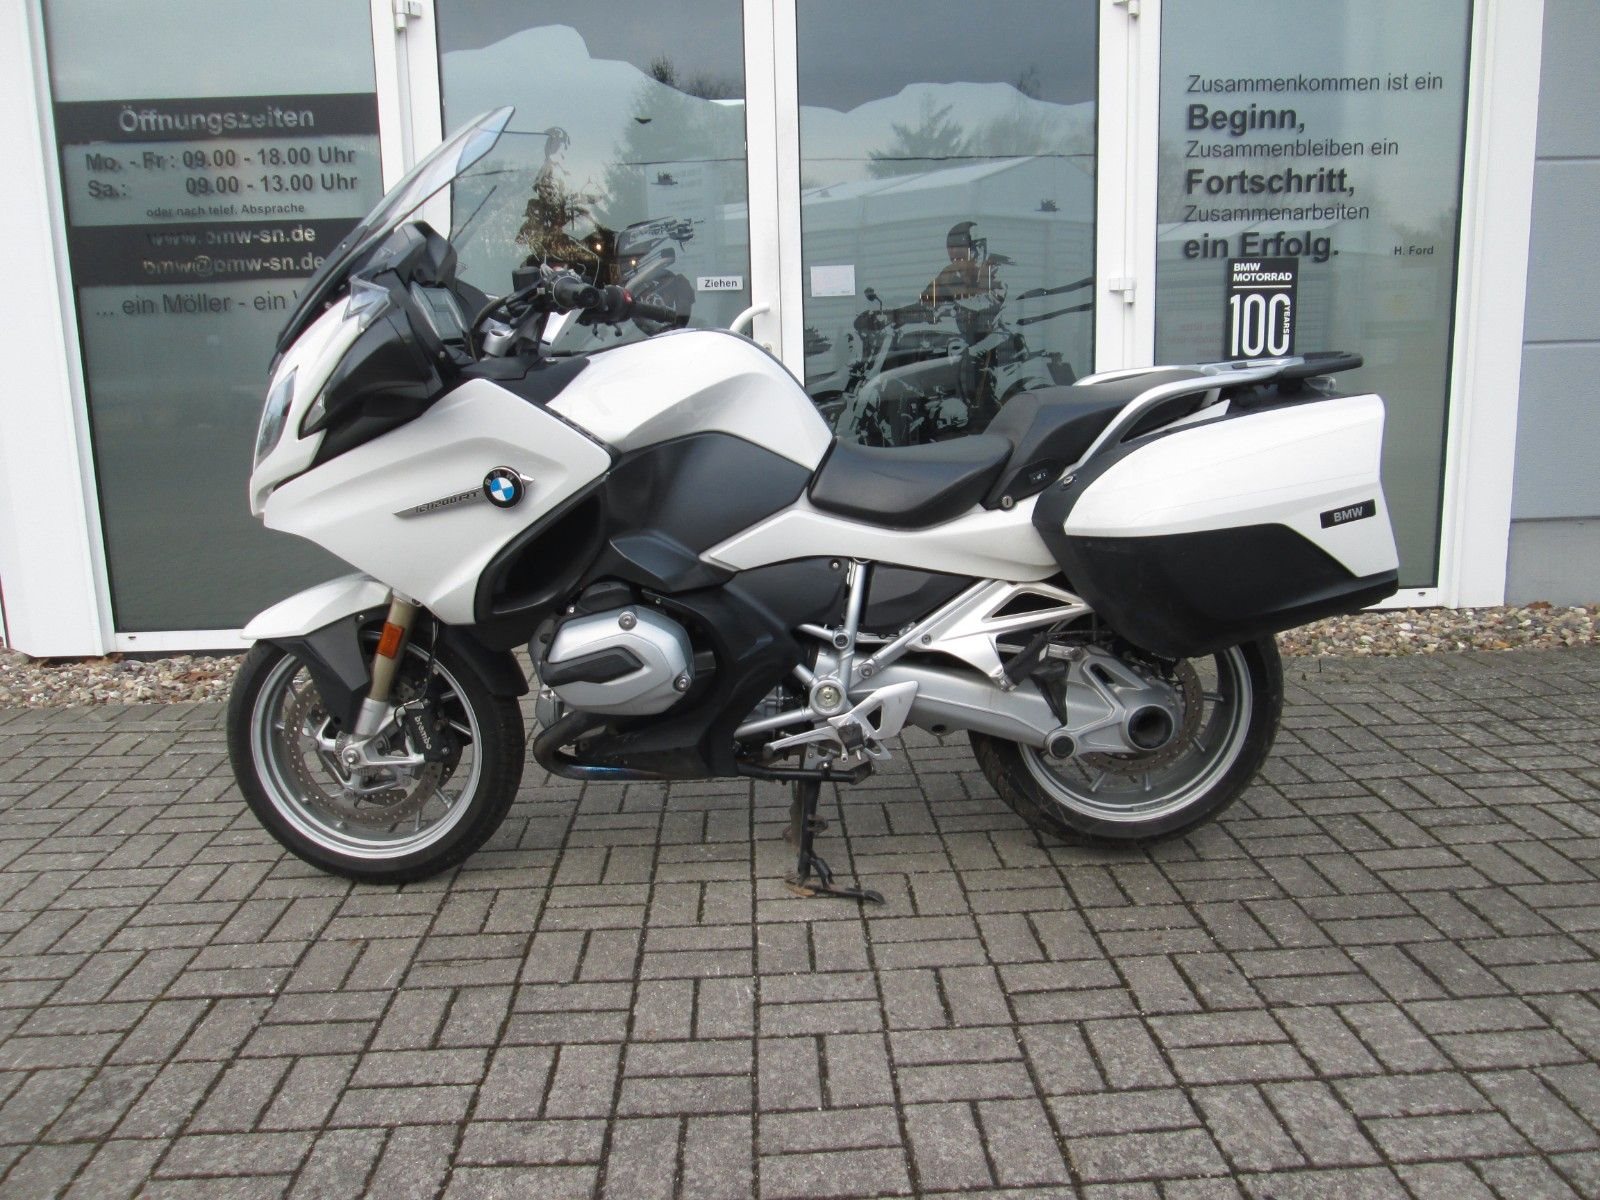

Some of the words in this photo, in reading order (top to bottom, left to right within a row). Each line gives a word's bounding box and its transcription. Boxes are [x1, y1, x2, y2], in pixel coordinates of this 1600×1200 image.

[1187, 74, 1380, 93] Zusammenkommen
[1387, 73, 1408, 91] ist
[1415, 72, 1443, 90] ein
[119, 104, 315, 135] Öffnungszeiten
[1187, 103, 1305, 137] Beginn,
[85, 153, 122, 171] Mo.
[183, 149, 236, 168] 09.00
[259, 147, 311, 166] 18.00
[318, 146, 355, 165] Uhr
[1186, 139, 1364, 159] Zusammenbleiben
[1371, 138, 1399, 156] ein
[88, 180, 126, 198] Sa.:
[186, 176, 239, 195] 09.00
[261, 174, 313, 192] 13.00
[321, 172, 358, 191] Uhr
[1186, 168, 1355, 196] Fortschritt,
[146, 208, 172, 218] oder
[177, 206, 205, 217] nach
[209, 205, 237, 216] telef.
[242, 202, 305, 216] Absprache
[1184, 204, 1369, 223] Zusammenarbeiten
[1184, 234, 1229, 258] ein
[1240, 231, 1339, 263] Erfolg.
[1394, 246, 1408, 256] H.
[1409, 245, 1434, 256] Ford
[1233, 263, 1261, 272] BMW
[1233, 272, 1293, 282] MOTORRAD
[704, 278, 738, 288] Ziehen
[122, 298, 154, 315] ein
[163, 294, 231, 313] Möller
[253, 292, 287, 310] ein
[1230, 293, 1291, 357] 100
[1283, 305, 1291, 334] YEARS
[1333, 506, 1362, 522] BMW
[414, 715, 432, 750] brembo
